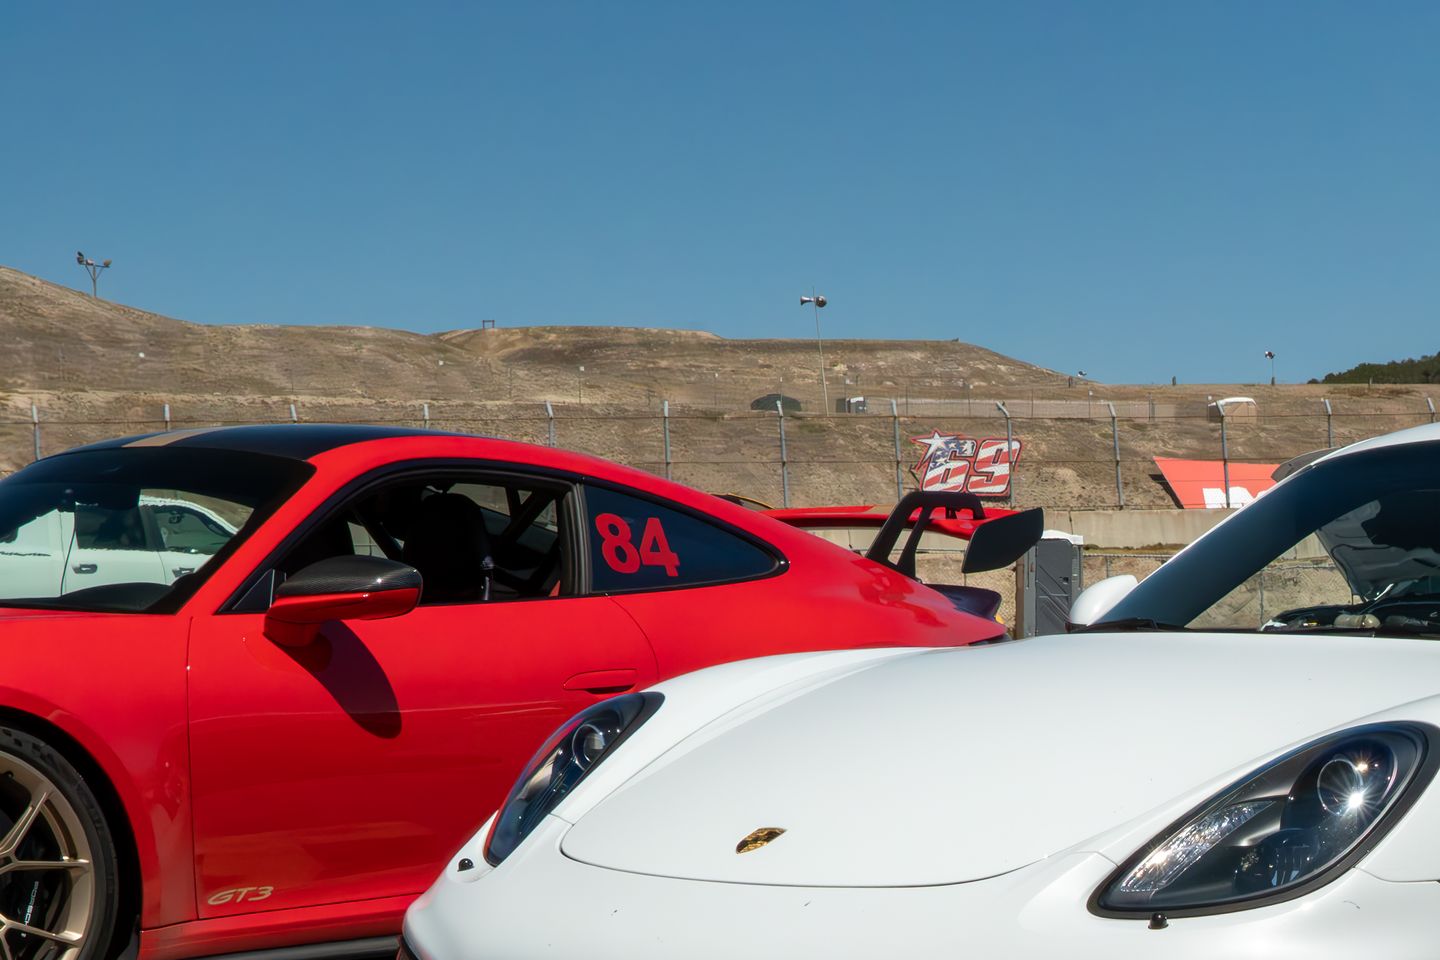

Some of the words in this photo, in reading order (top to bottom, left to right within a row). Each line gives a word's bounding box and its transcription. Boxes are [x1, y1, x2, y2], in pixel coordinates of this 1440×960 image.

[921, 438, 1022, 495] 69
[594, 513, 681, 577] 84
[207, 885, 274, 906] GT3
